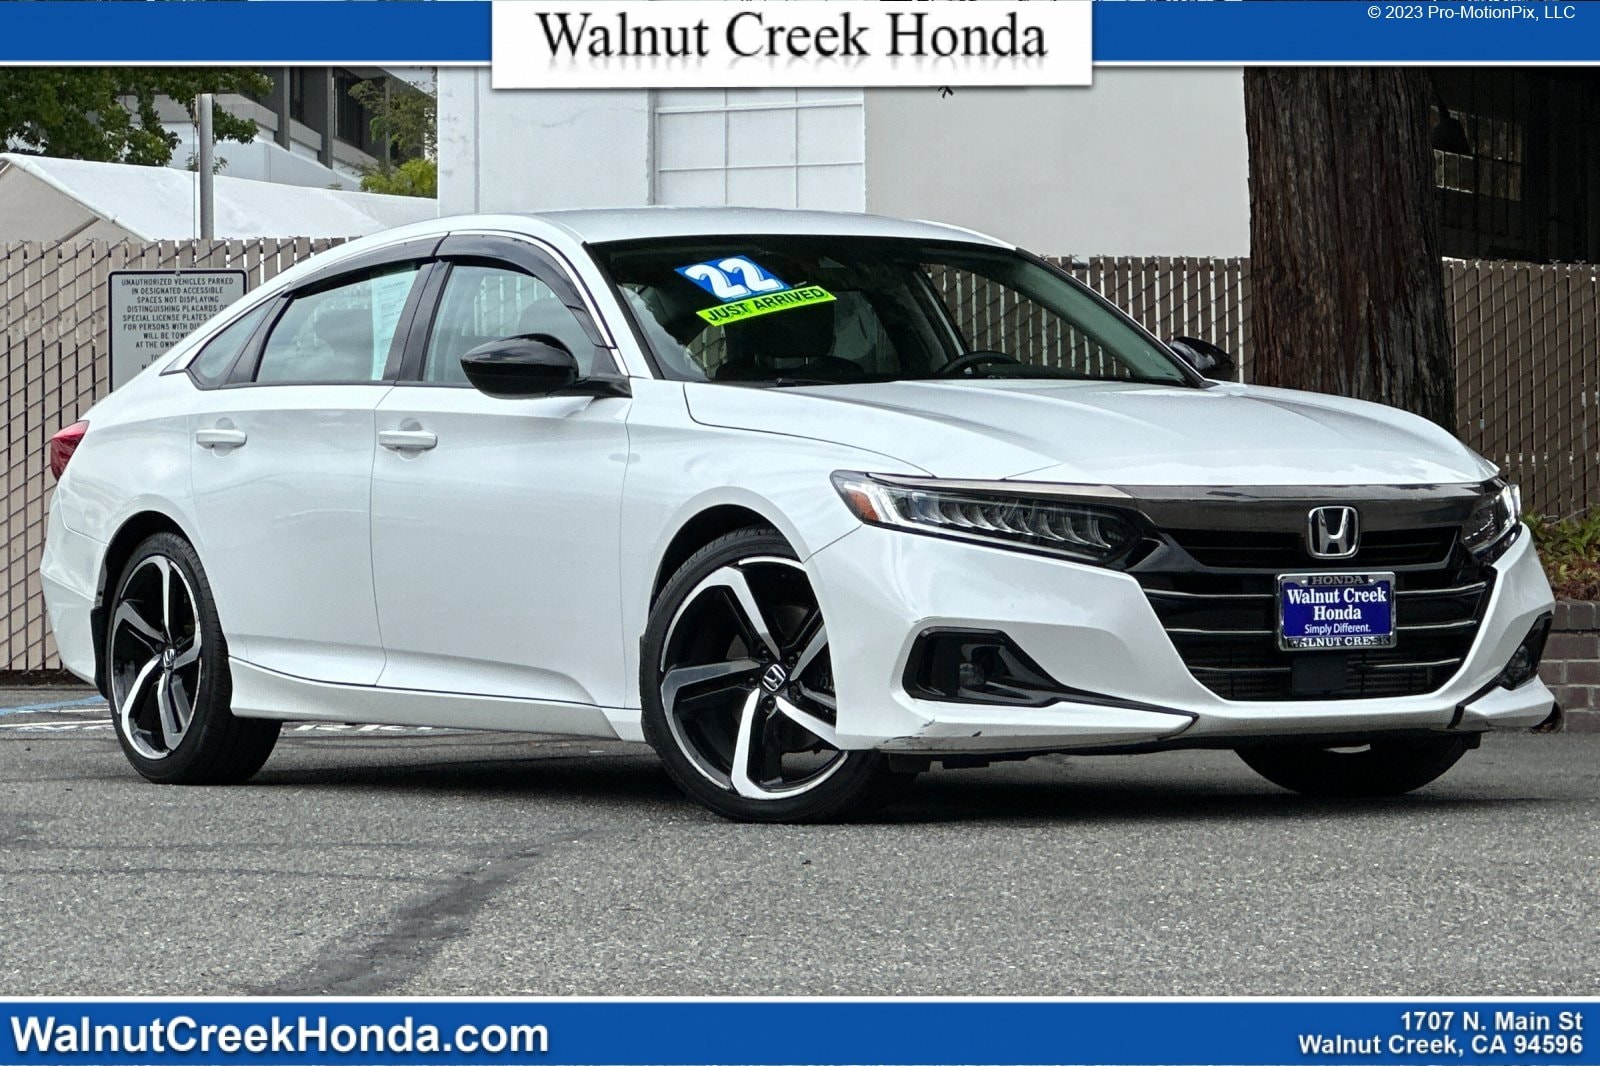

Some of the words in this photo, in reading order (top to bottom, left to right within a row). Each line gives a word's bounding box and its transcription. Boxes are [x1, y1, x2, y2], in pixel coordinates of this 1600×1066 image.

[174, 278, 206, 286] VEHICLES
[208, 277, 234, 285] PARKED
[685, 258, 784, 298] 22
[141, 287, 181, 295] DESIGNATED
[709, 302, 748, 321] JUST
[755, 288, 826, 310] ARRIVED
[1312, 576, 1364, 584] HONDA
[1287, 589, 1340, 604] Walnut
[1343, 587, 1387, 602] Creek
[1313, 605, 1362, 620] Honda
[1304, 623, 1331, 635] Simply
[1333, 623, 1371, 632] Different.
